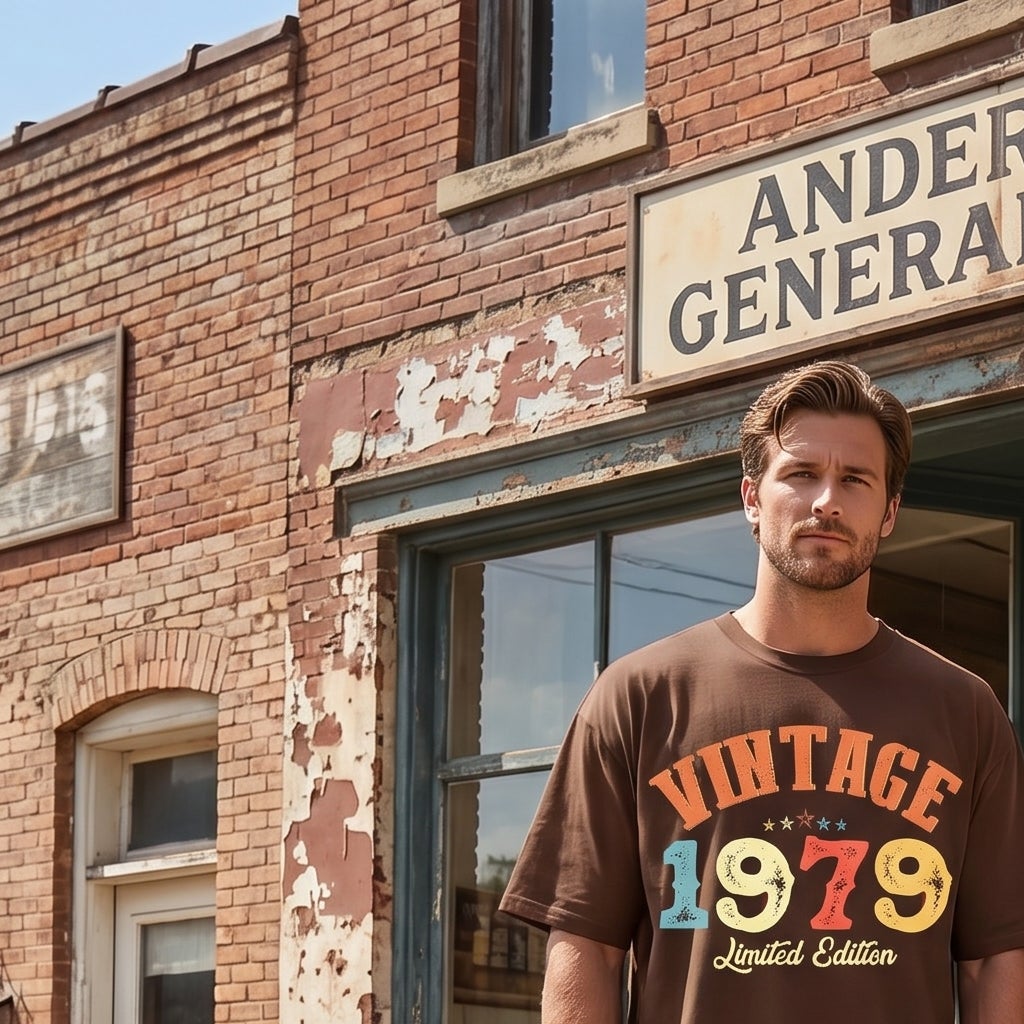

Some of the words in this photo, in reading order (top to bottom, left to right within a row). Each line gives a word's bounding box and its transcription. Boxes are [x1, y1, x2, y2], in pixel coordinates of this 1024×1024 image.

[648, 724, 963, 833] VINTAGE
[659, 835, 953, 933] 1979
[713, 936, 804, 974] Limited
[810, 936, 898, 968] Edition
